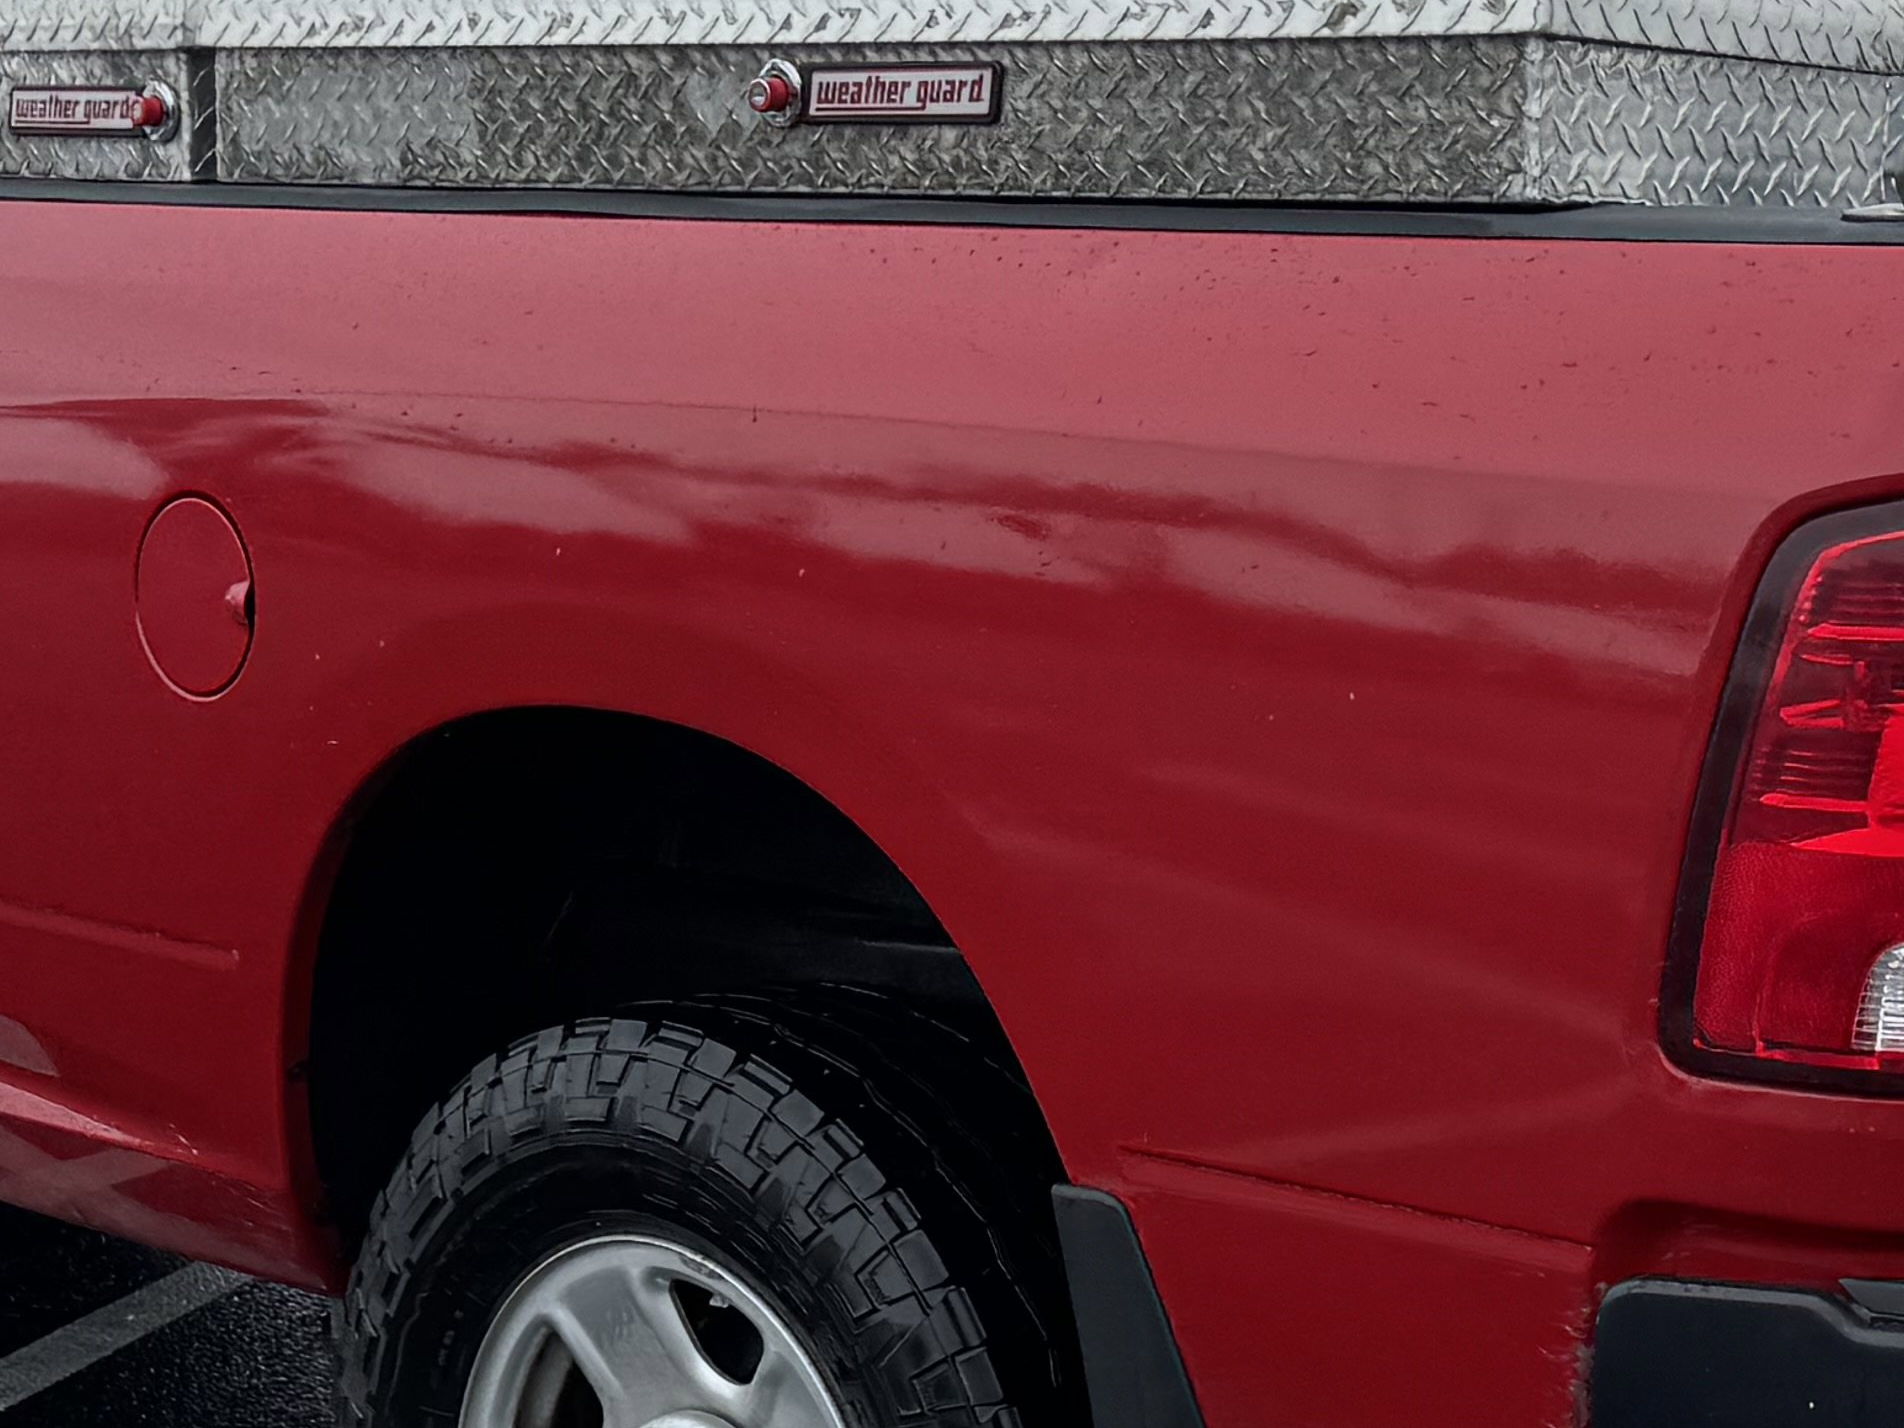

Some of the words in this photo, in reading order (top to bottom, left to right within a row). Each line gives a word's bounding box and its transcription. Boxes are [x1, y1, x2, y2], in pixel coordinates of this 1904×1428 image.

[15, 93, 80, 118] weather
[84, 95, 131, 124] guard
[816, 75, 912, 105] weather
[916, 73, 984, 111] guard
